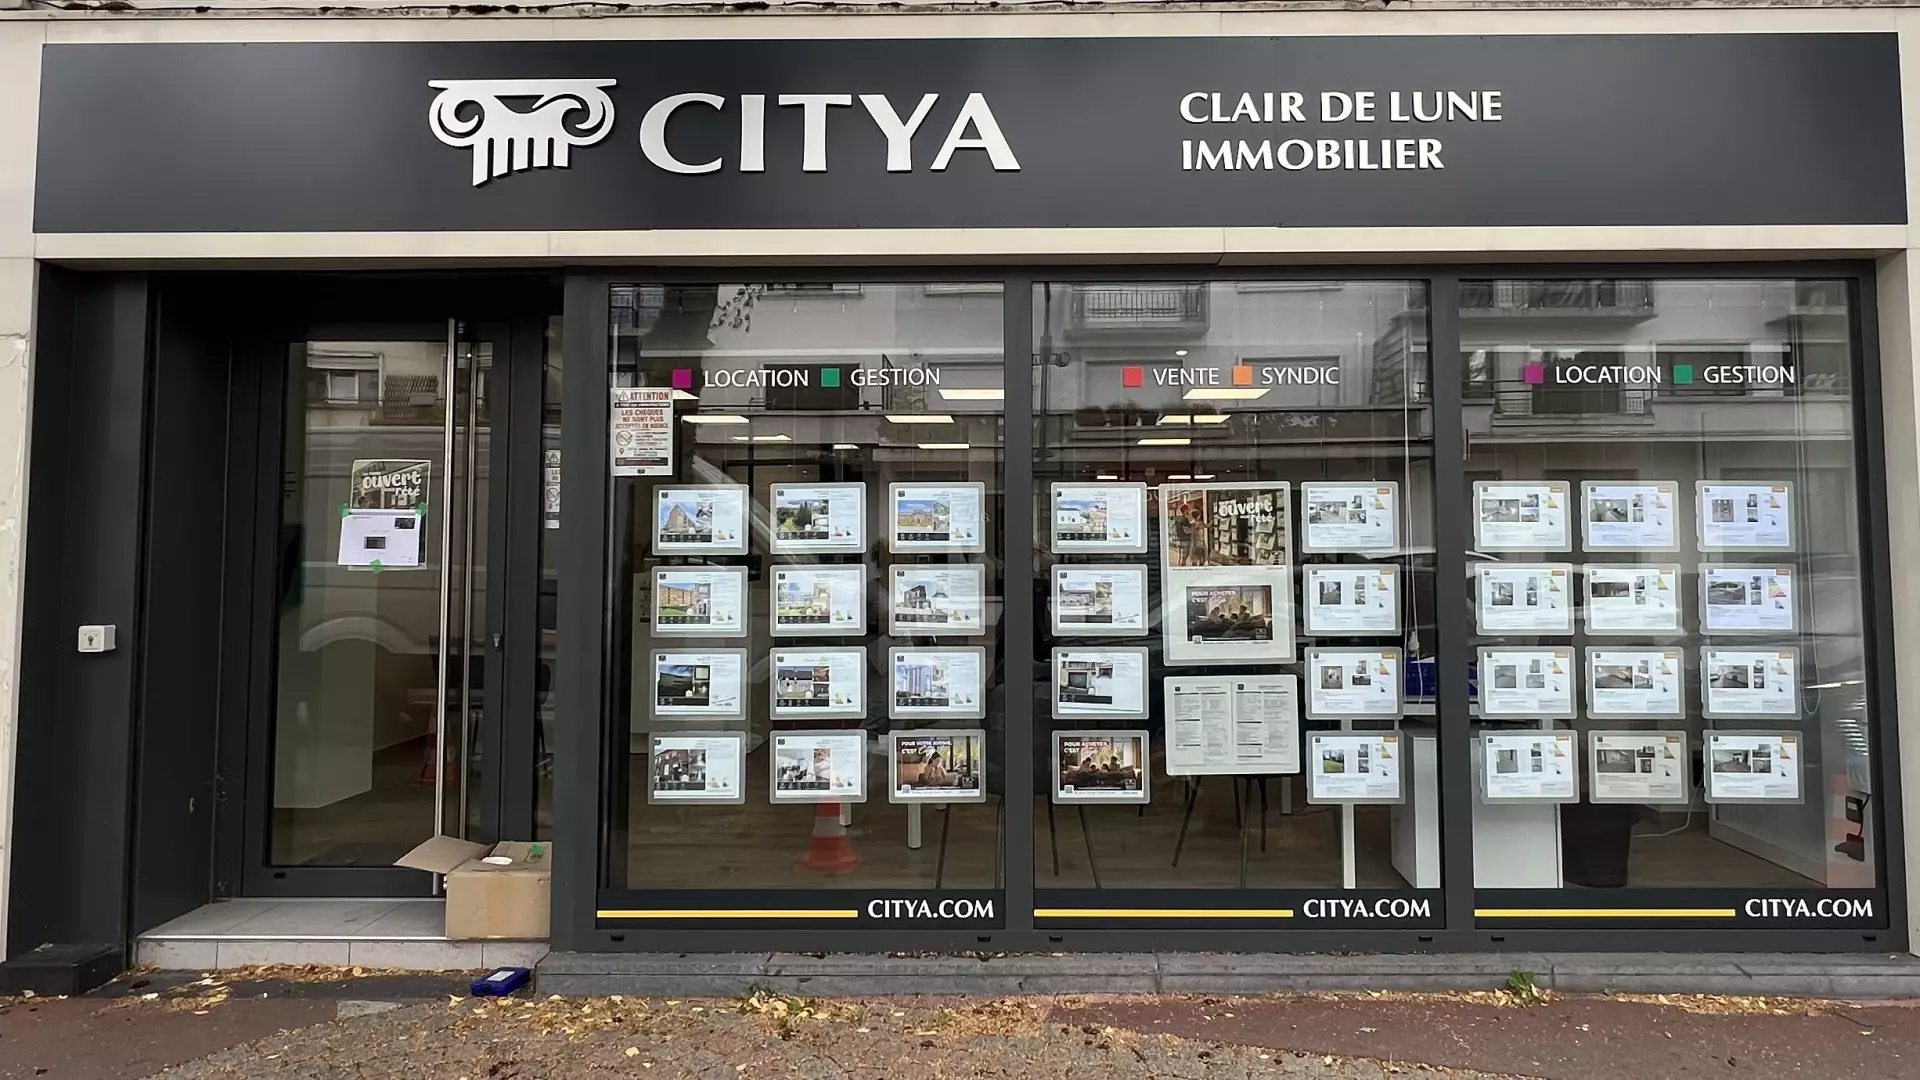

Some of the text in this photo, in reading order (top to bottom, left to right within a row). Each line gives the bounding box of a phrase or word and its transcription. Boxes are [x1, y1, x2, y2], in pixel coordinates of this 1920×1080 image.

[1179, 90, 1503, 123] CLAIR DE LUNE
[639, 92, 1021, 174] CITYA
[1182, 138, 1445, 170] IMMOBILIER
[703, 368, 809, 388] LOCATION
[850, 367, 941, 387] GESTION
[1152, 367, 1221, 386] VENTE
[1260, 366, 1340, 385] SYNDIC
[1554, 365, 1662, 385] LOCATION
[1703, 365, 1796, 384] GESTION
[630, 391, 669, 401] ATTENTION
[362, 471, 421, 489] ouvert
[1219, 500, 1273, 517] ouvert
[867, 899, 995, 919] CITYA.COM
[1303, 898, 1431, 918] CITYA.COM
[1744, 898, 1872, 918] CITYA.COM
